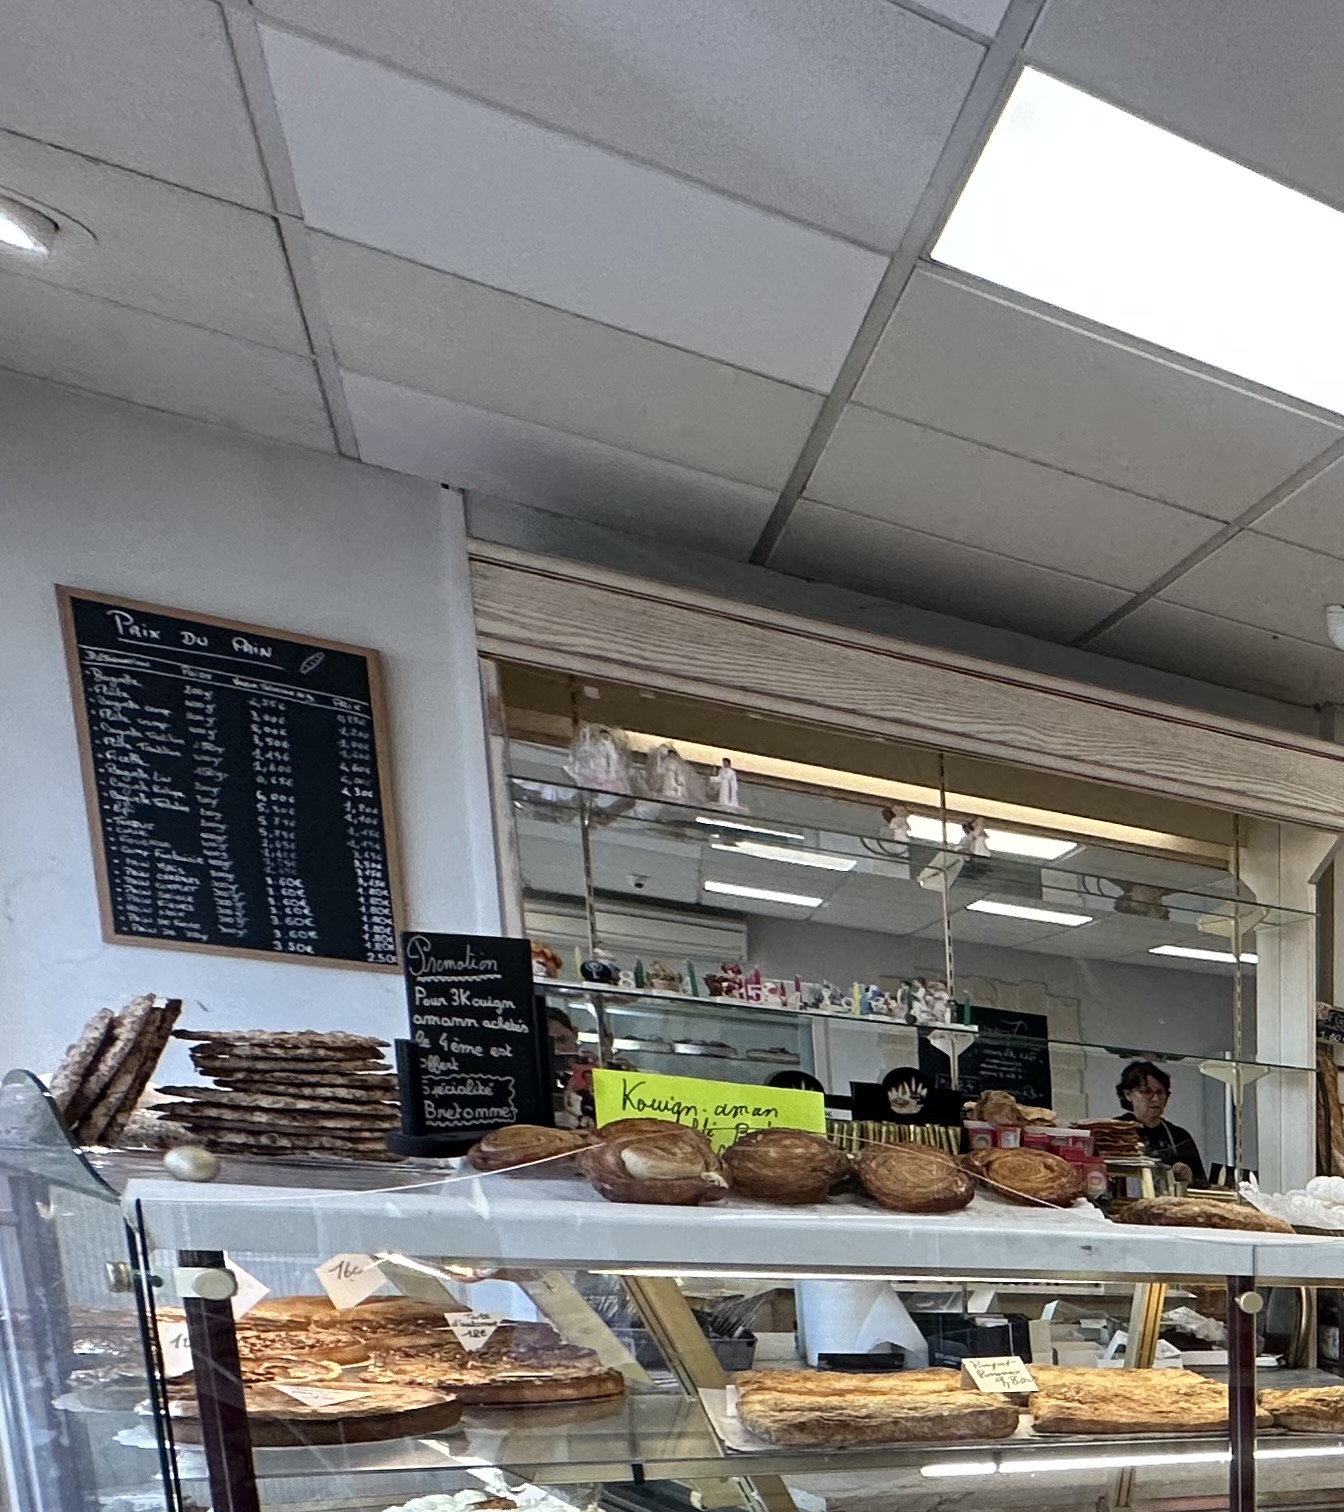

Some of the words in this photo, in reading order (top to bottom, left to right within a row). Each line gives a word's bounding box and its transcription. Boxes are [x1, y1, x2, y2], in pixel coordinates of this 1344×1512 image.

[406, 935, 498, 976] Promotion
[414, 986, 448, 1006] Pour
[489, 1044, 513, 1058] est
